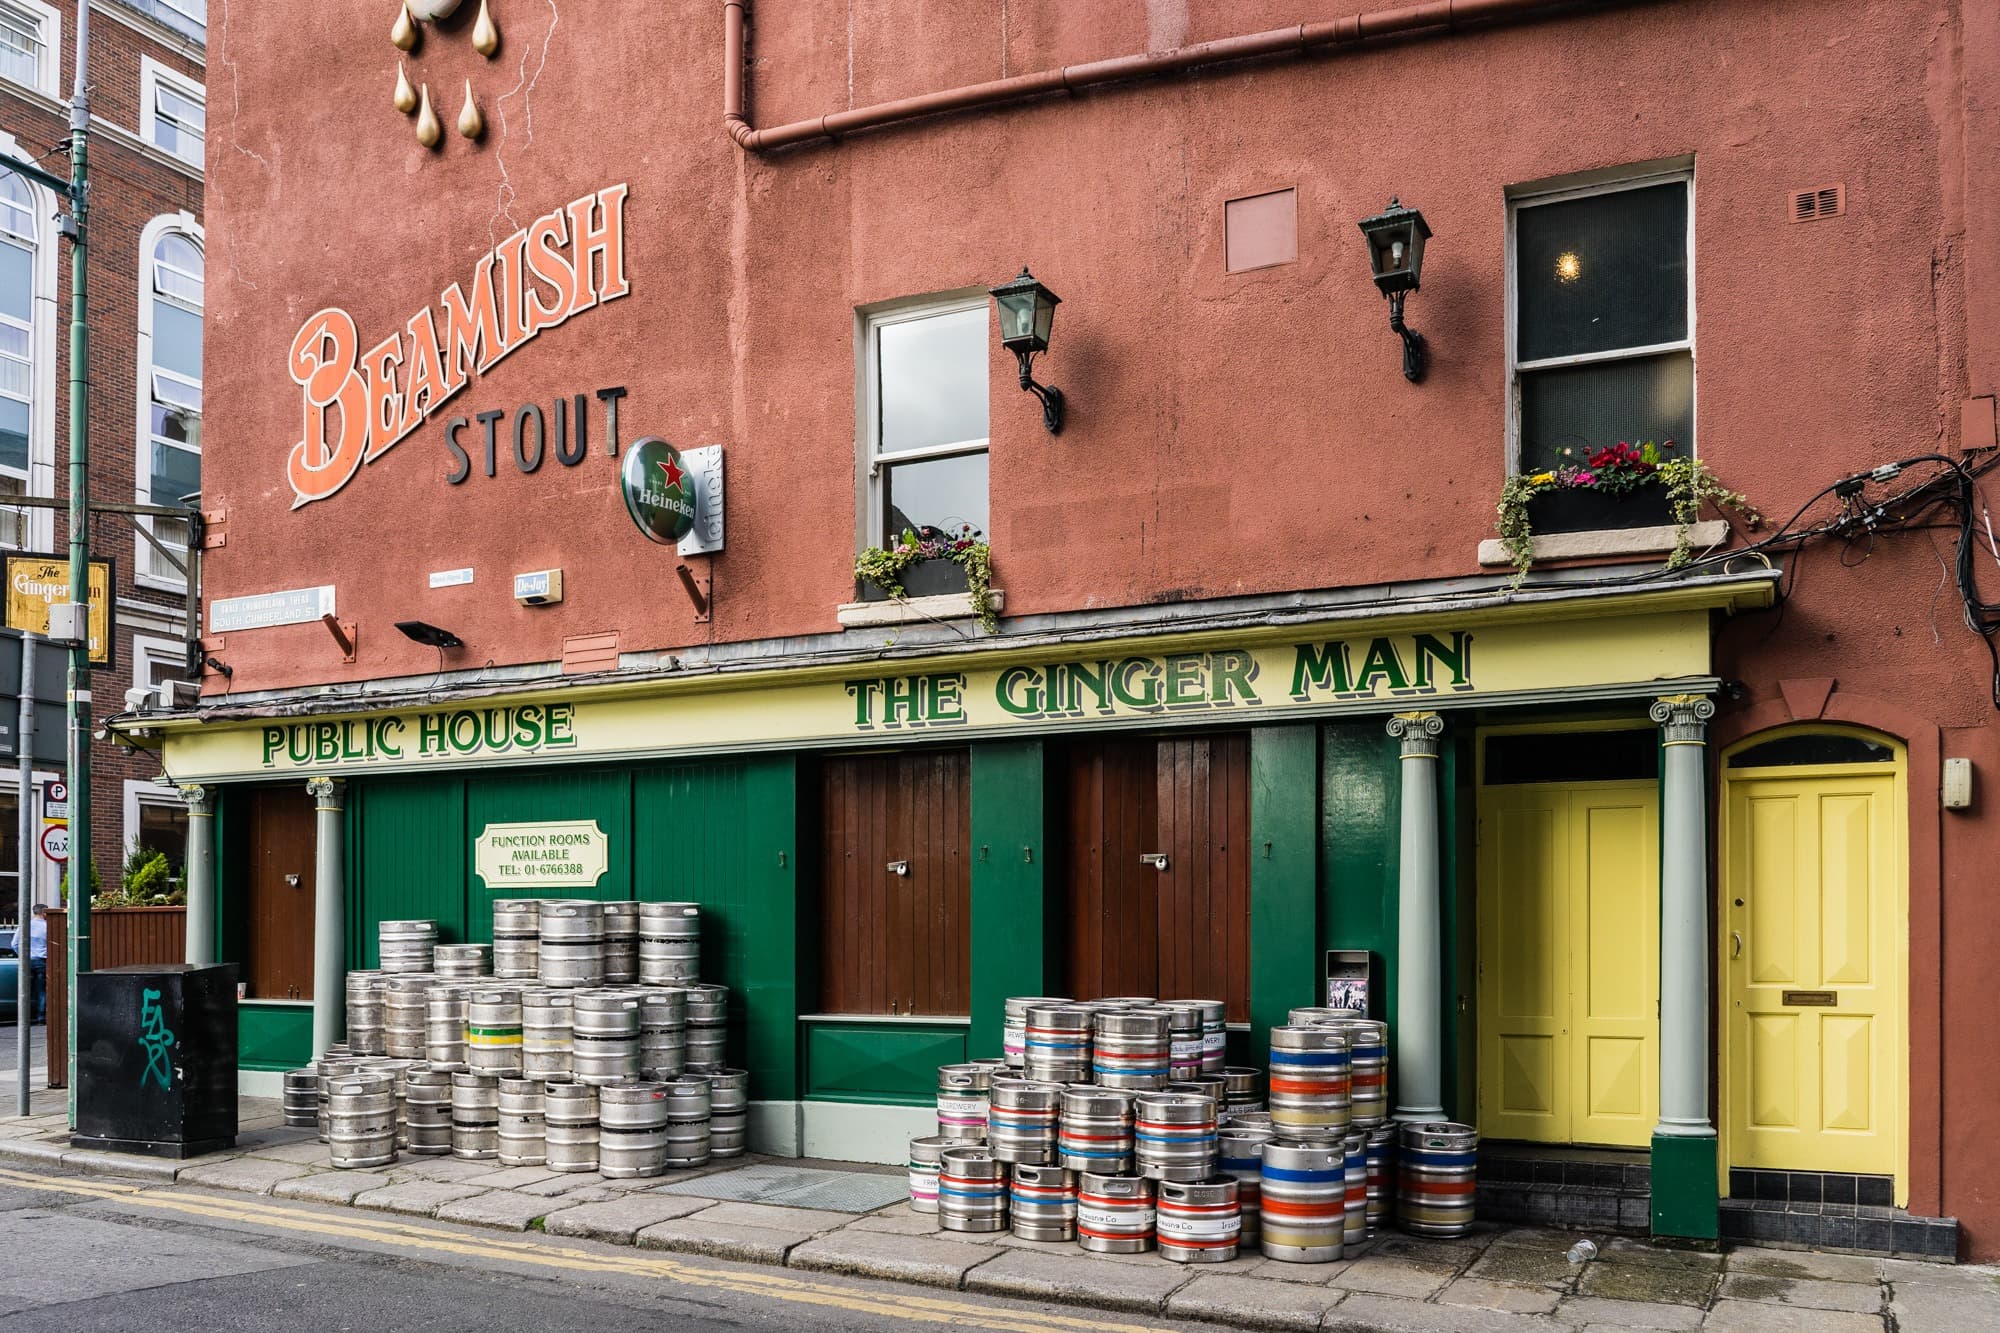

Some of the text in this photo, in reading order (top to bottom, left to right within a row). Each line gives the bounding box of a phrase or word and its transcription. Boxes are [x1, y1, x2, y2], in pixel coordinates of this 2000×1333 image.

[287, 182, 631, 511] BEAMISH
[445, 386, 626, 485] STOUT
[638, 488, 695, 519] Heineken
[37, 565, 60, 579] The
[13, 573, 70, 603] Ginger
[214, 616, 242, 629] SOUTH
[245, 609, 302, 626] CUMBERLAND
[845, 631, 1474, 731] THE GINGER MAN
[262, 703, 577, 767] PUBLIC HOUSE
[48, 841, 68, 852] TAX
[491, 833, 591, 848] FUNCTION ROOMS
[511, 848, 570, 861] AVAILABLE
[498, 863, 583, 876] TEL: 01-6766388
